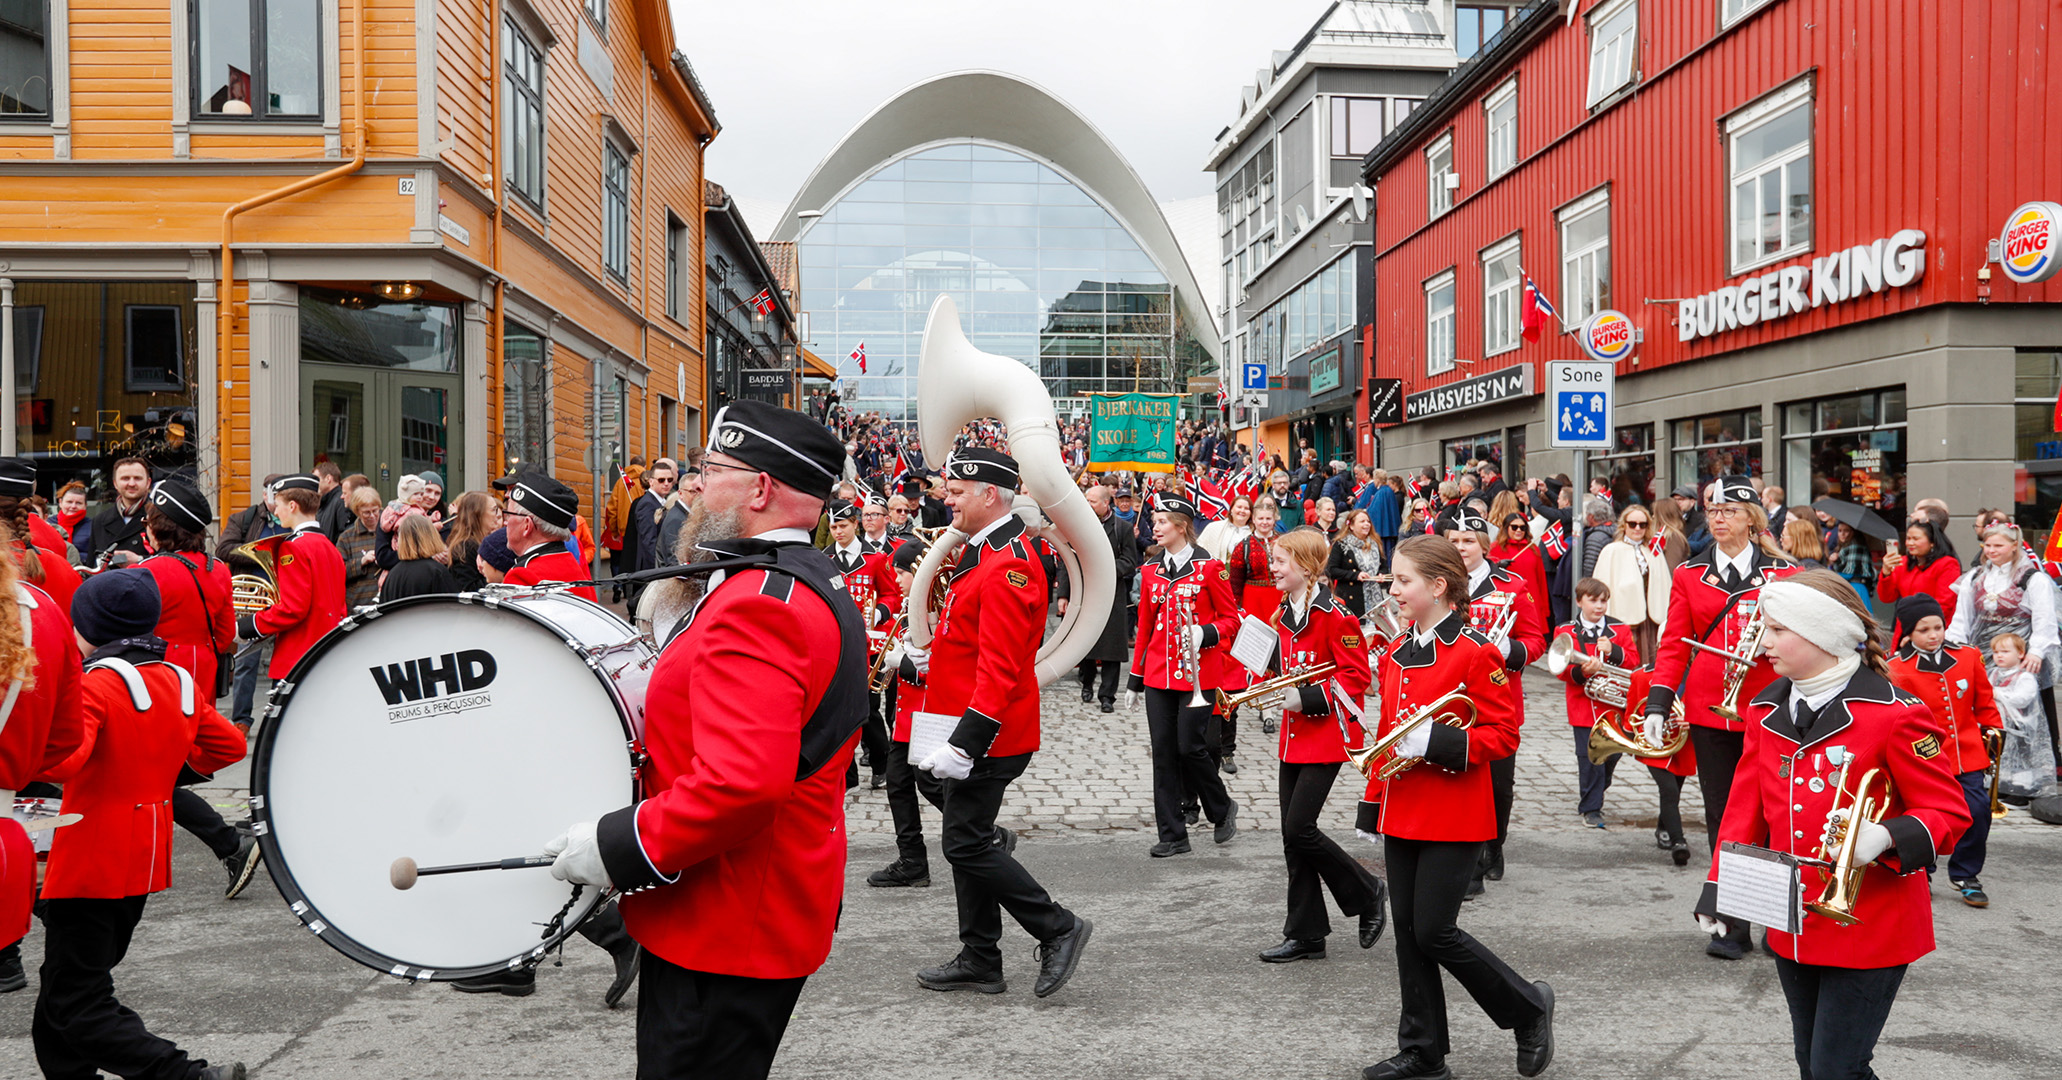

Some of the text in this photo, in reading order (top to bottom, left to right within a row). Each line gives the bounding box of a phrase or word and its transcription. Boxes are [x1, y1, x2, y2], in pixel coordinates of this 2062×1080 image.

[401, 181, 414, 192] 82
[2006, 218, 2050, 243] BURGER
[2006, 232, 2050, 260] KING
[1678, 228, 1927, 342] BURGER KING
[1592, 321, 1627, 337] BURGER
[1593, 329, 1629, 349] KING
[749, 375, 785, 384] BARDUS
[1248, 366, 1262, 386] P
[1562, 367, 1603, 382] Sone
[1418, 375, 1506, 416] HÅRSVEIS'N
[1097, 400, 1172, 421] BJERKAKER
[1096, 429, 1138, 445] SKOLE
[47, 440, 89, 458] HOS
[1146, 451, 1167, 460] 1965
[1852, 448, 1881, 460] BACON
[369, 648, 498, 706] WHD
[388, 694, 491, 721] DRUMS & PERCUSSION
